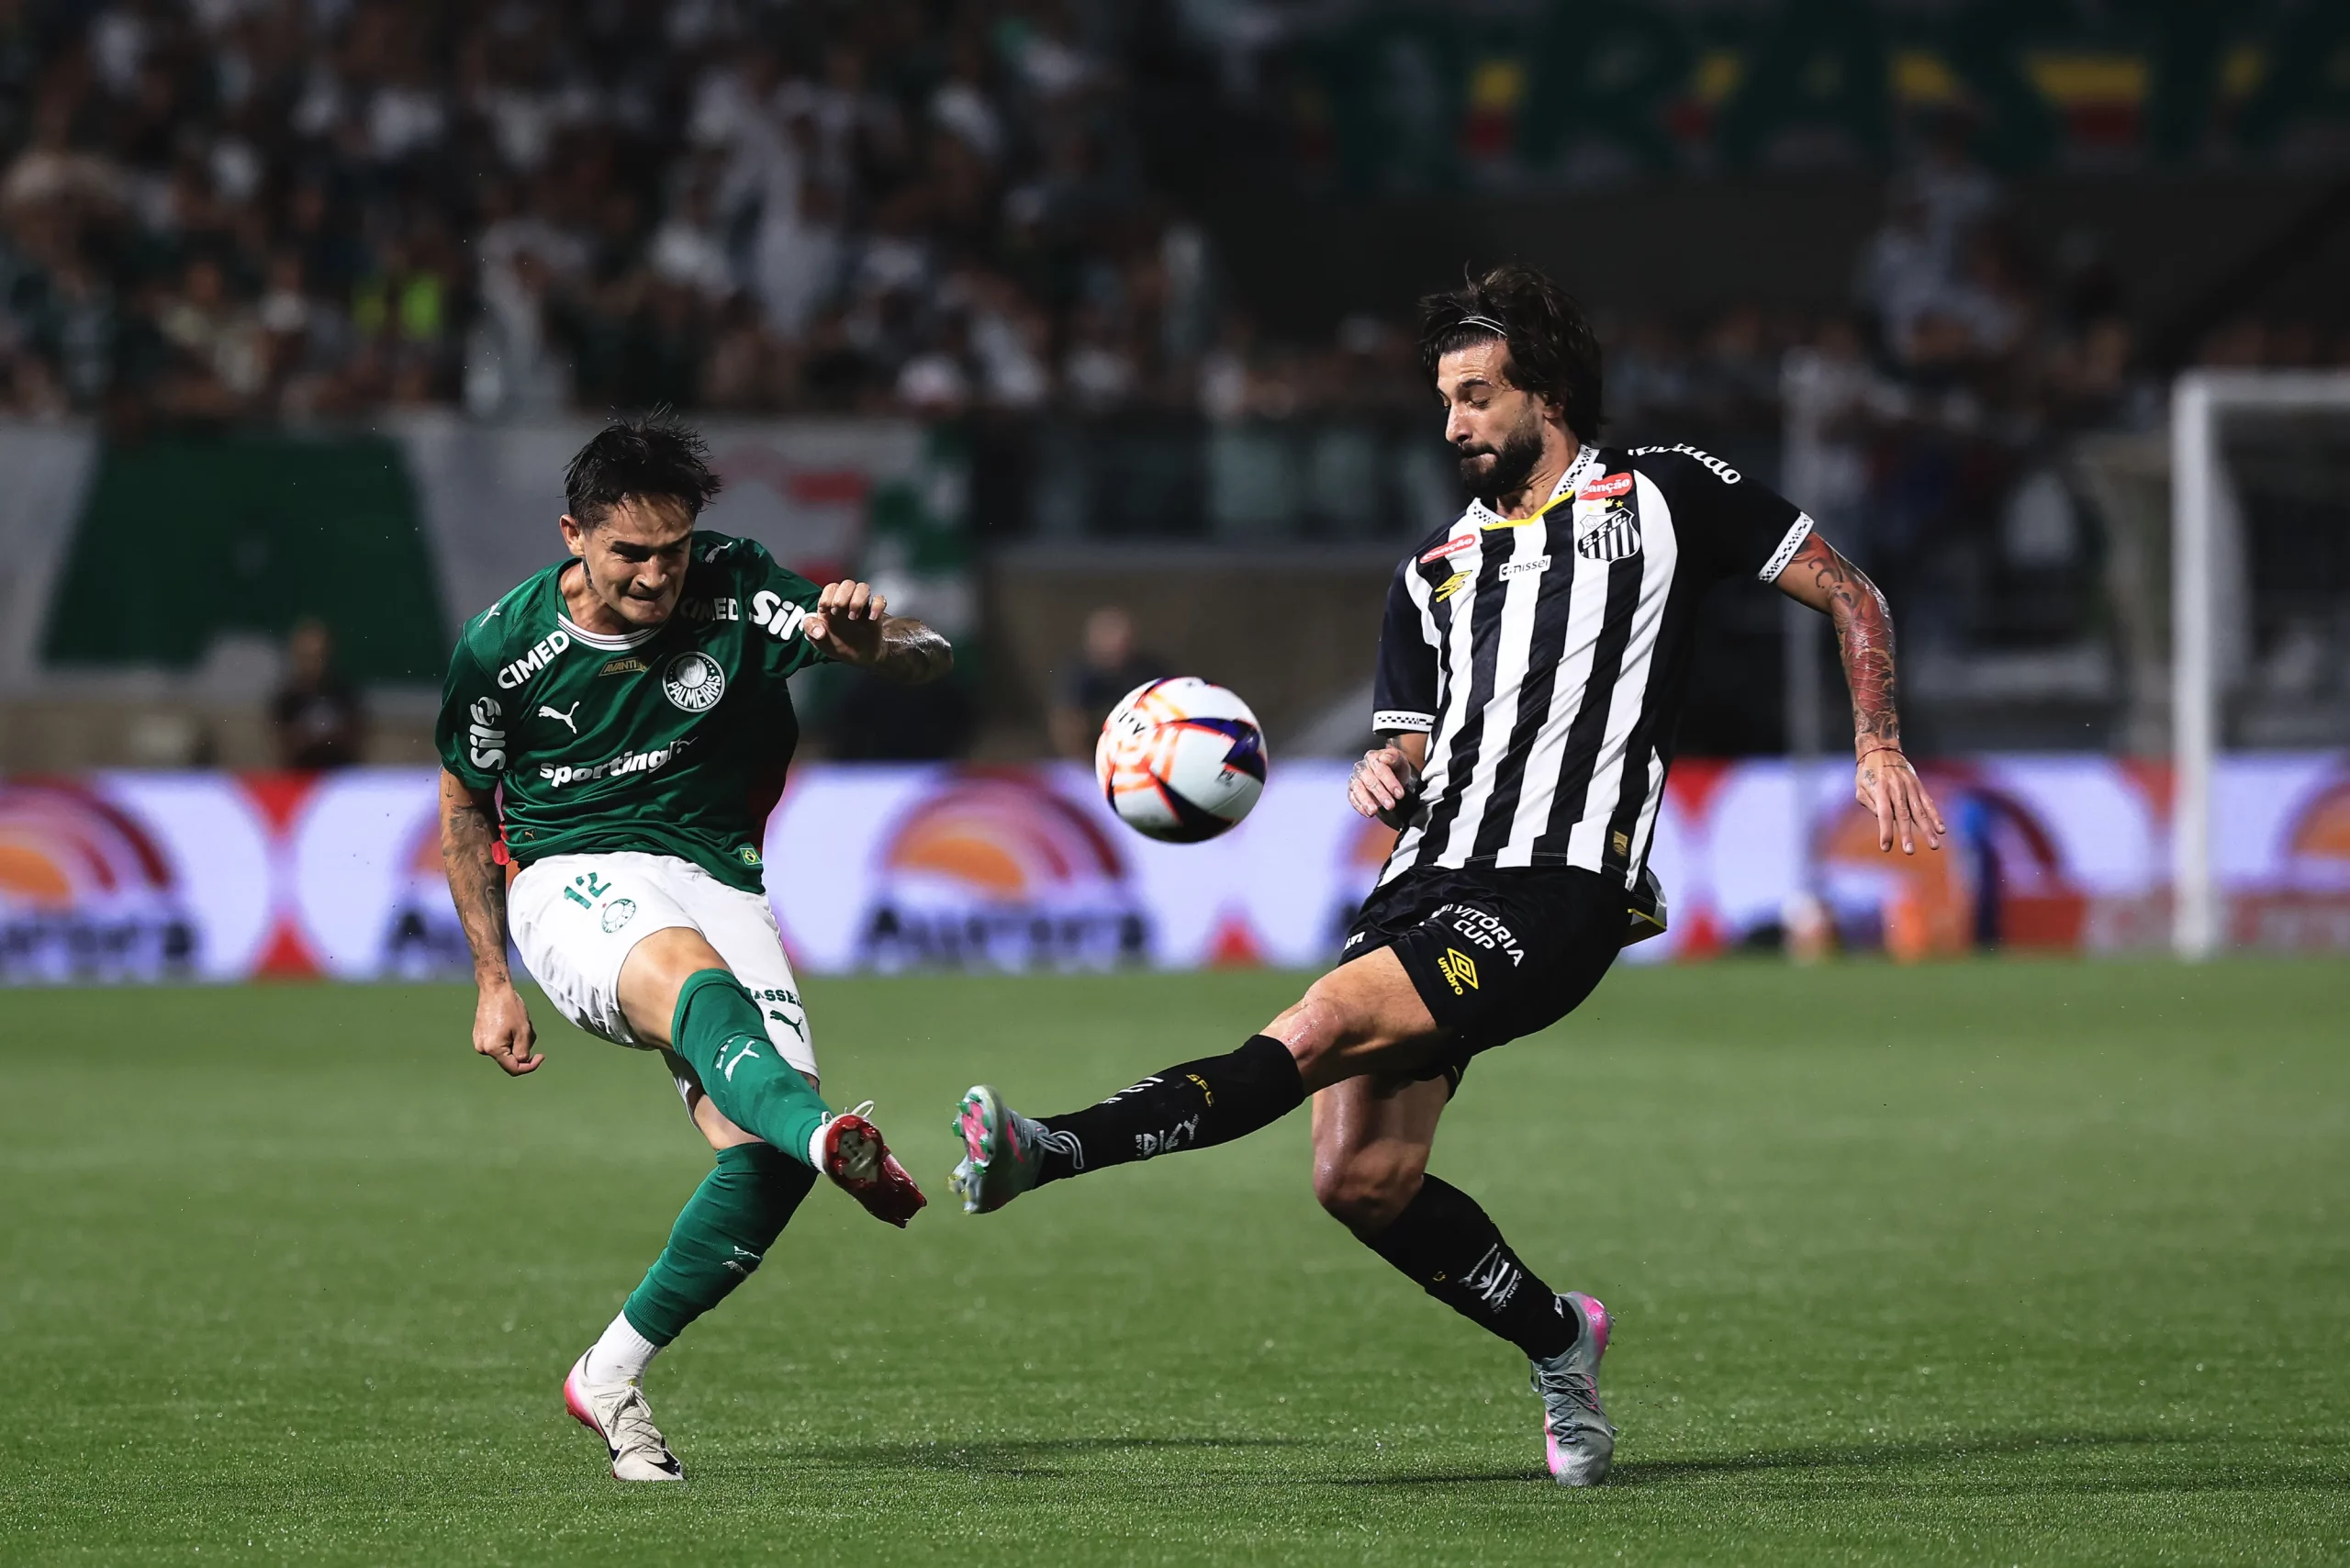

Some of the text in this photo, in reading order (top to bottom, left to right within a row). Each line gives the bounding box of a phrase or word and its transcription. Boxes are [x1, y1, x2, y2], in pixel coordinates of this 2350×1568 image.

[680, 597, 739, 622] CIMED
[748, 590, 806, 641] Sil
[498, 630, 570, 689] CIMED
[603, 659, 638, 674] AVANTI
[666, 675, 722, 709] PALMEIRAS
[469, 723, 507, 770] Sil
[540, 737, 688, 789] sporting
[564, 871, 612, 910] 12
[1452, 919, 1496, 949] CUP
[1453, 904, 1525, 968] VITÓRIA
[1437, 957, 1464, 996] umbro
